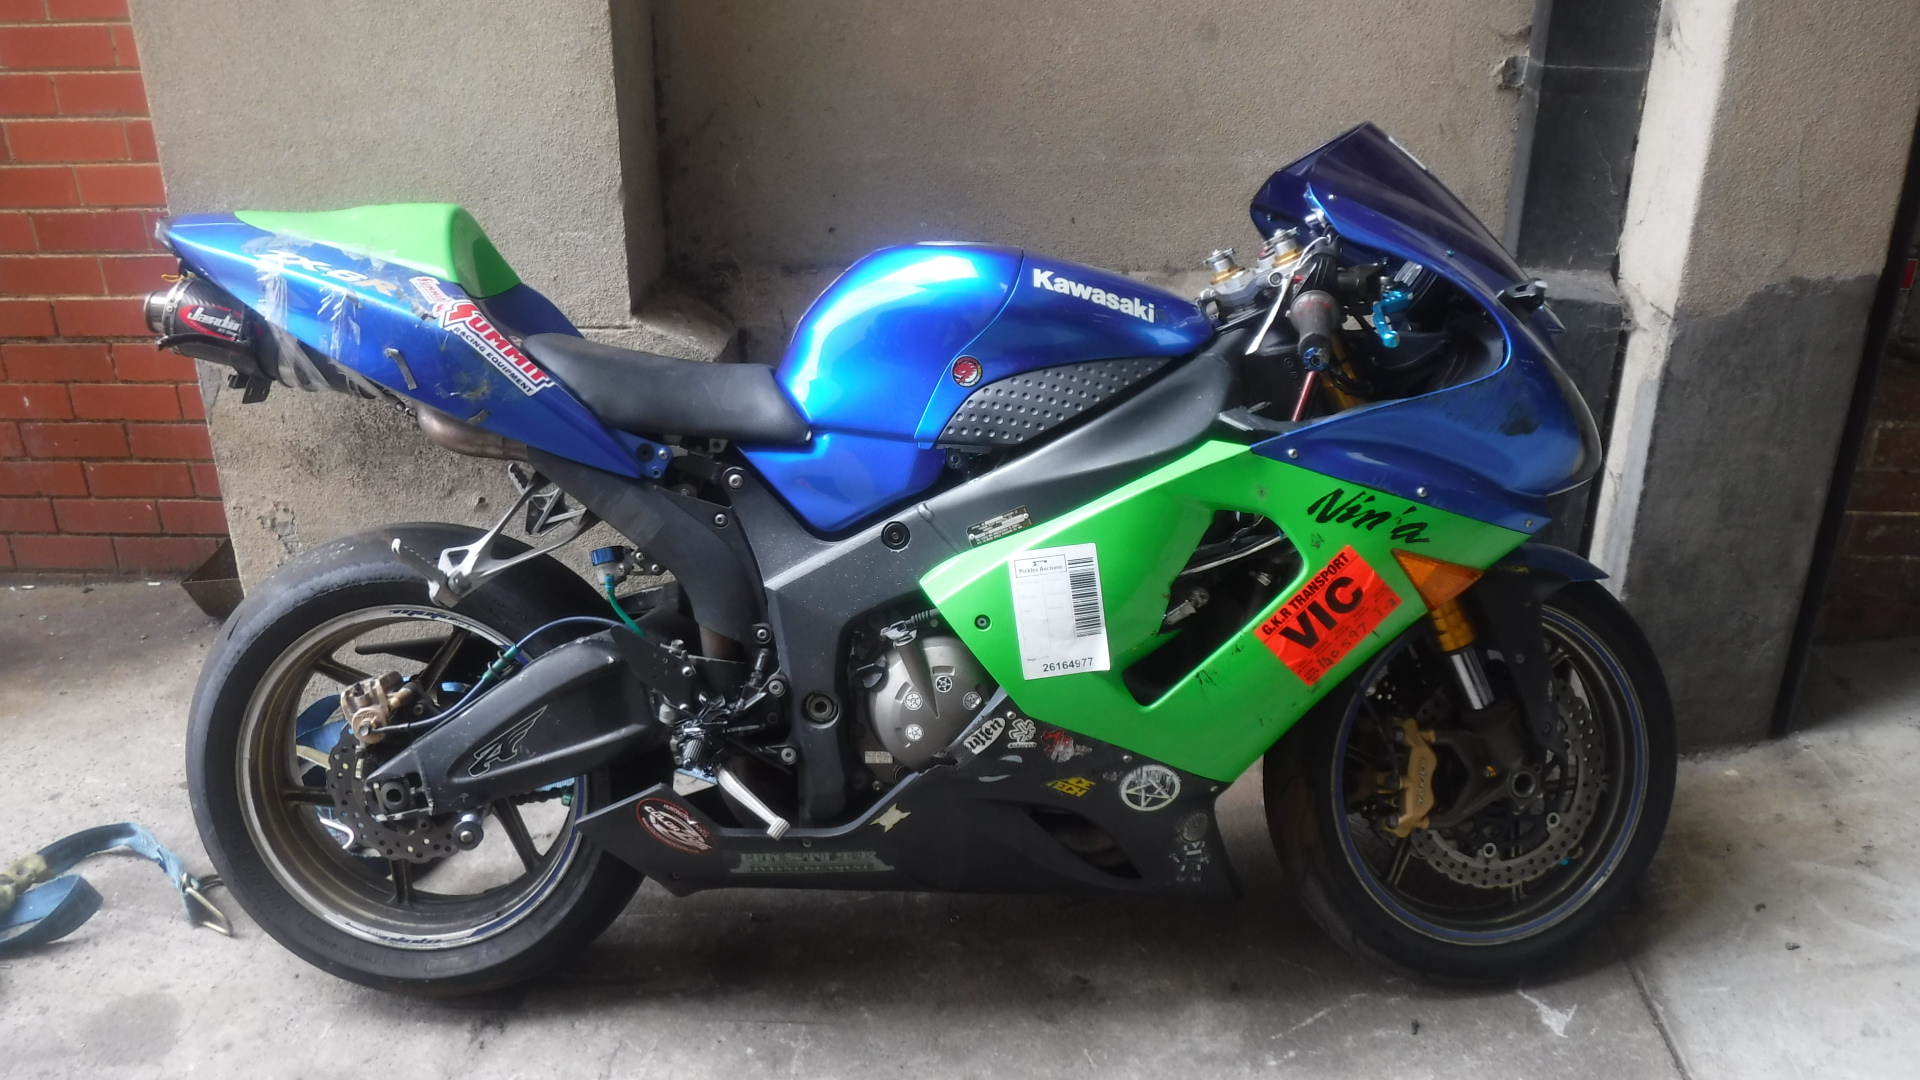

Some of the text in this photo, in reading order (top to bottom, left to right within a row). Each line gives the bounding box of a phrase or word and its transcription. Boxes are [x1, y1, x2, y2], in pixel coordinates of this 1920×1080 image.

[1033, 268, 1155, 323] Kawasaki
[448, 303, 549, 382] SUMMIT
[454, 327, 534, 394] RACING EQUIPMENT
[1018, 564, 1063, 576] Pickles Auctions
[1288, 552, 1351, 611] TRANSPORT
[1278, 576, 1364, 650] VIC
[1042, 657, 1094, 673] 26164977
[643, 805, 681, 833] COLOR
